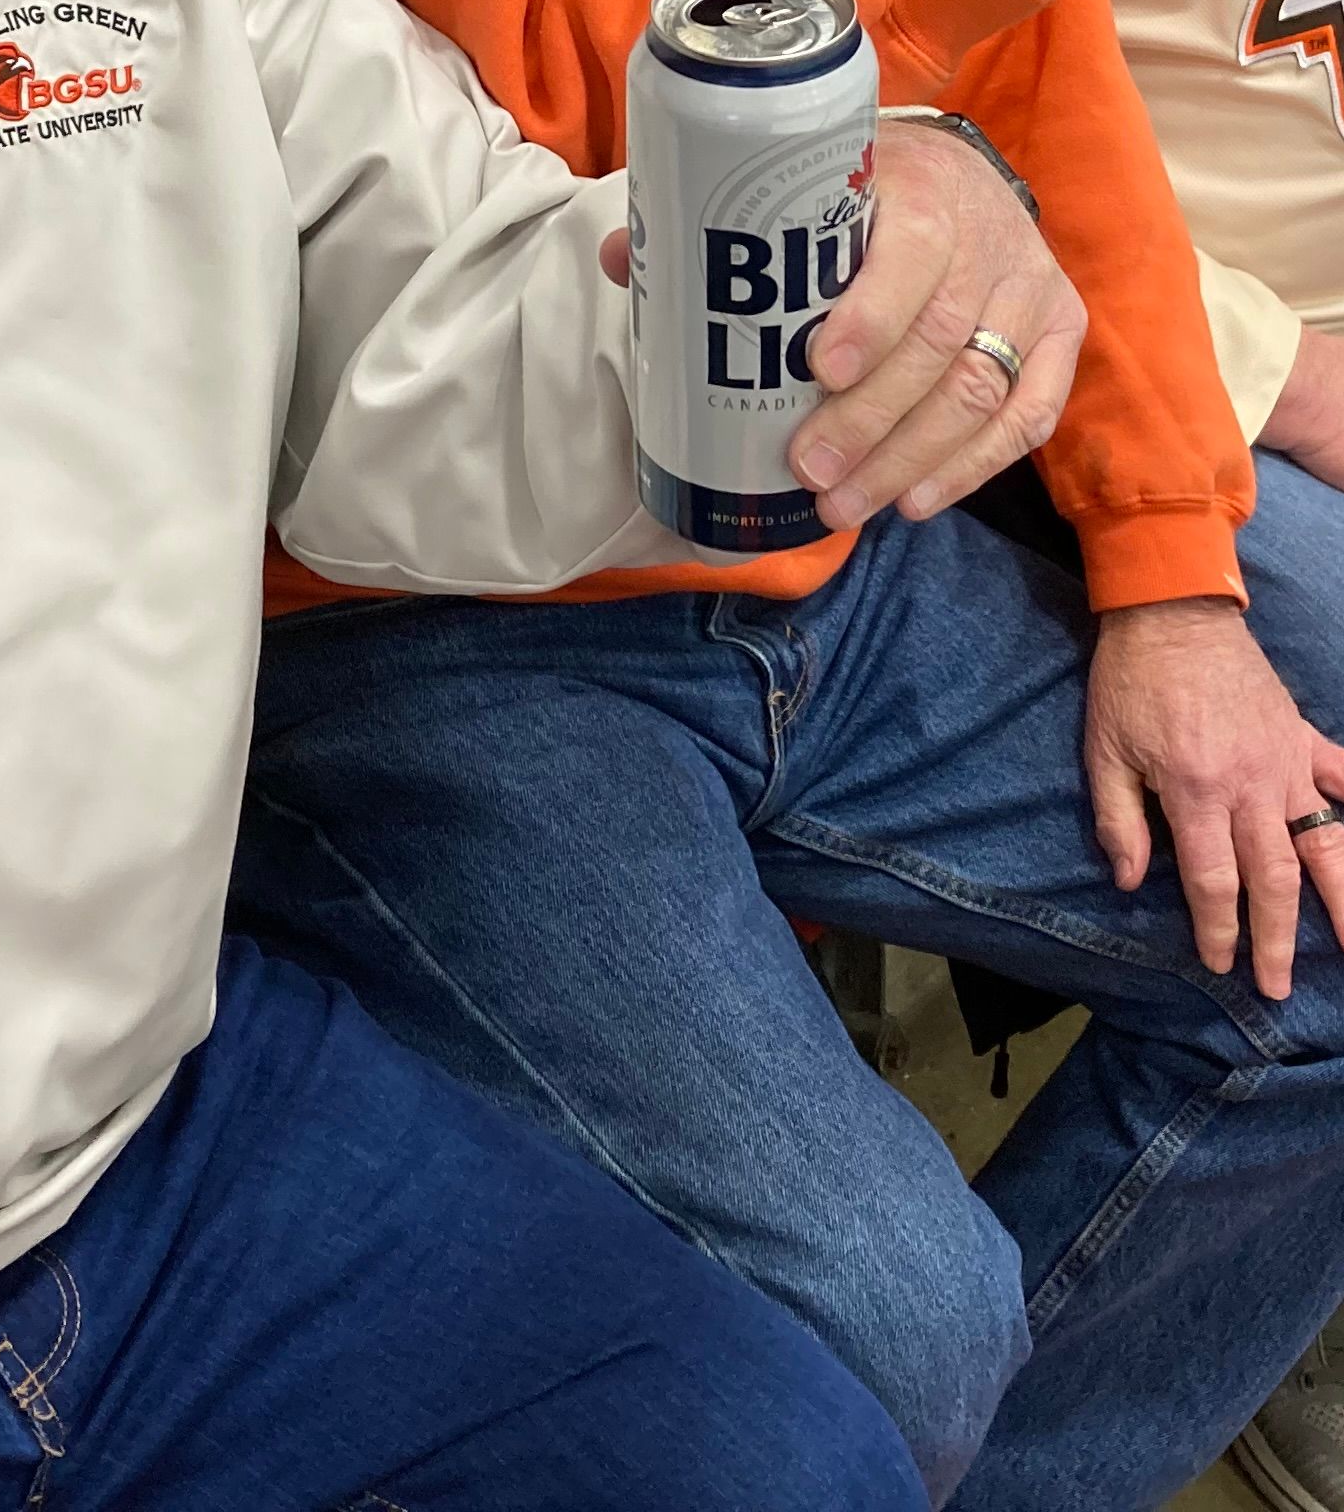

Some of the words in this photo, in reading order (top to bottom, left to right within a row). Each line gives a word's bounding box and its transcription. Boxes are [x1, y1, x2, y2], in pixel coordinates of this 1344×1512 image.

[53, 2, 148, 41] GREEN
[27, 64, 134, 110] BGSU
[37, 103, 144, 140] UNIVERSITY
[707, 511, 775, 527] IMPORTED
[780, 508, 815, 524] LIGHT
